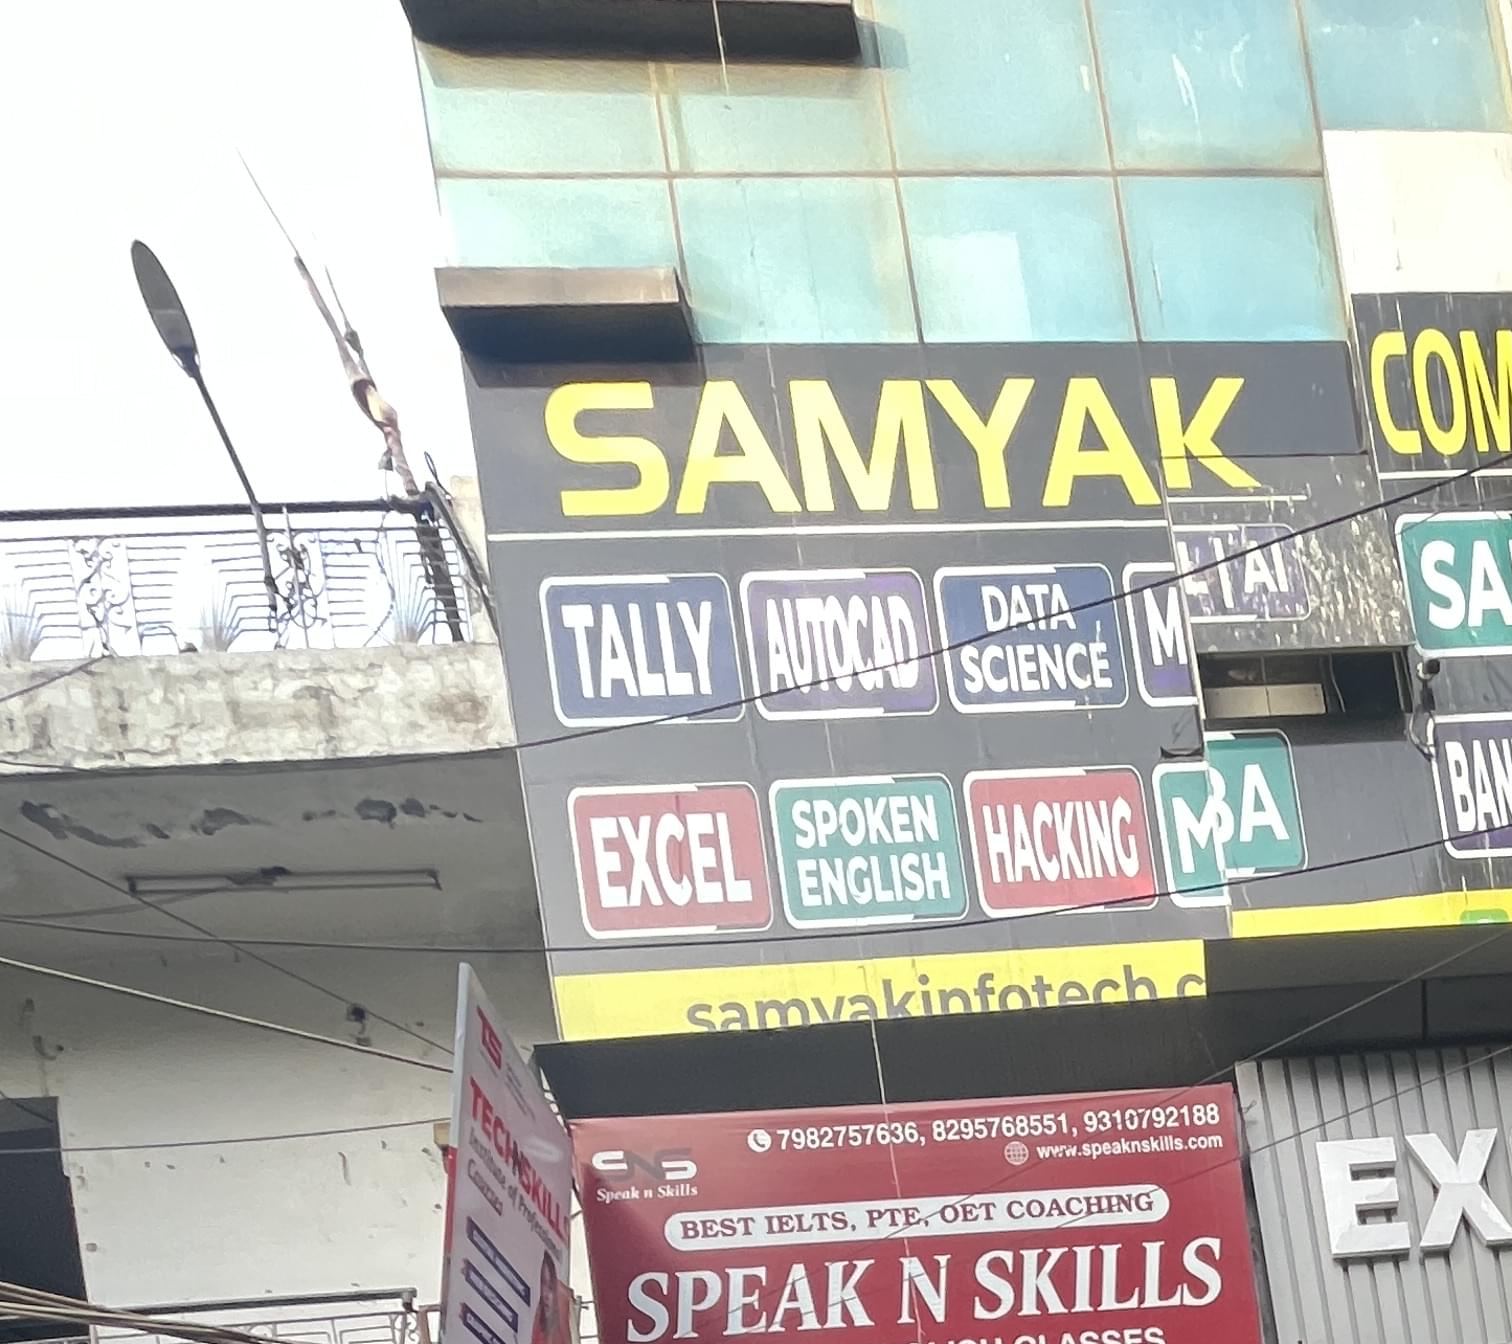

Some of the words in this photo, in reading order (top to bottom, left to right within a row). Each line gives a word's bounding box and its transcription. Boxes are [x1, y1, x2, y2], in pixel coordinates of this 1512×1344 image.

[543, 376, 1262, 518] SAMYAK
[981, 583, 1077, 634] DATA
[563, 599, 713, 701] TALLY
[766, 594, 920, 699] AUTOCAD
[960, 641, 1114, 695] SCIENCE
[791, 796, 938, 849] SPOKEN
[981, 796, 1140, 884] HACKING
[588, 812, 752, 909] EXCEL
[799, 852, 952, 907] ENGLISH
[776, 1120, 926, 1151] 7982757636,
[932, 1111, 1079, 1142] 8295768551,
[1083, 1103, 1221, 1133] 9310792188
[1037, 1133, 1224, 1160] www.speaknskills.com
[596, 1187, 640, 1205] Speak
[657, 1183, 698, 1199] Skills
[681, 1217, 755, 1241] BEST
[766, 1209, 858, 1237] IELTS,
[867, 1205, 930, 1232] PTE,
[939, 1202, 997, 1224] OET
[1006, 1192, 1155, 1221] COACHING
[626, 1259, 877, 1344] SPEAK
[899, 1254, 951, 1326] N
[973, 1236, 1224, 1322] SKILLS
